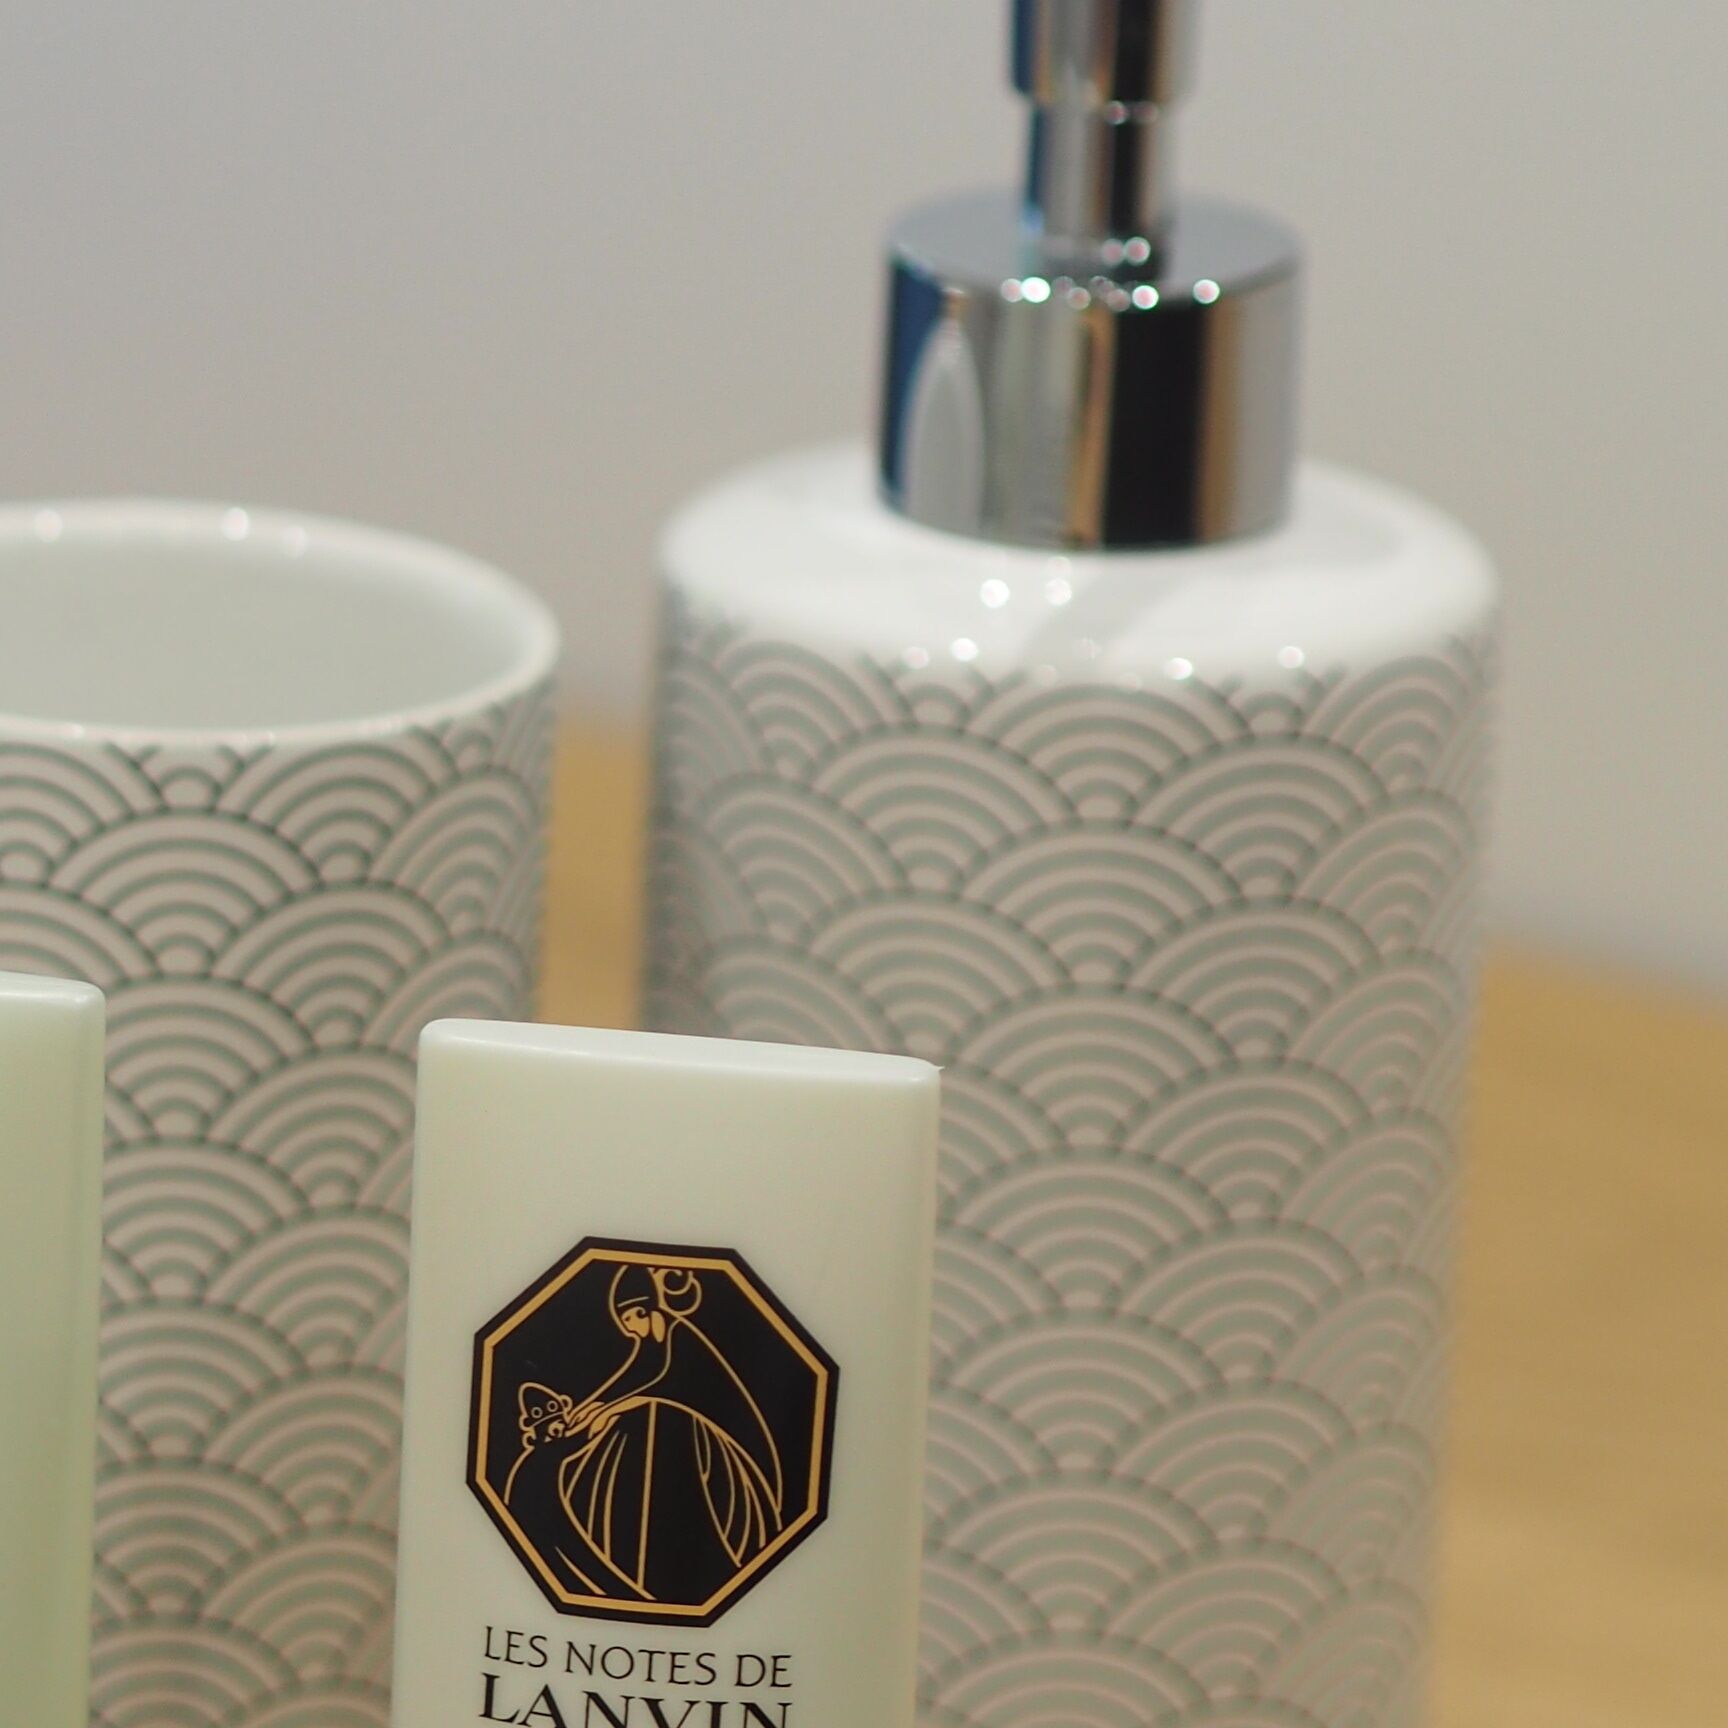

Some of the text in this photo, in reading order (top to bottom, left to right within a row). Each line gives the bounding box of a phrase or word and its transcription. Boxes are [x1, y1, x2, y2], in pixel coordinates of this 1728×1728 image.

[482, 1625, 794, 1688] LES NOTES DE
[477, 1672, 794, 1728] LANVIN
